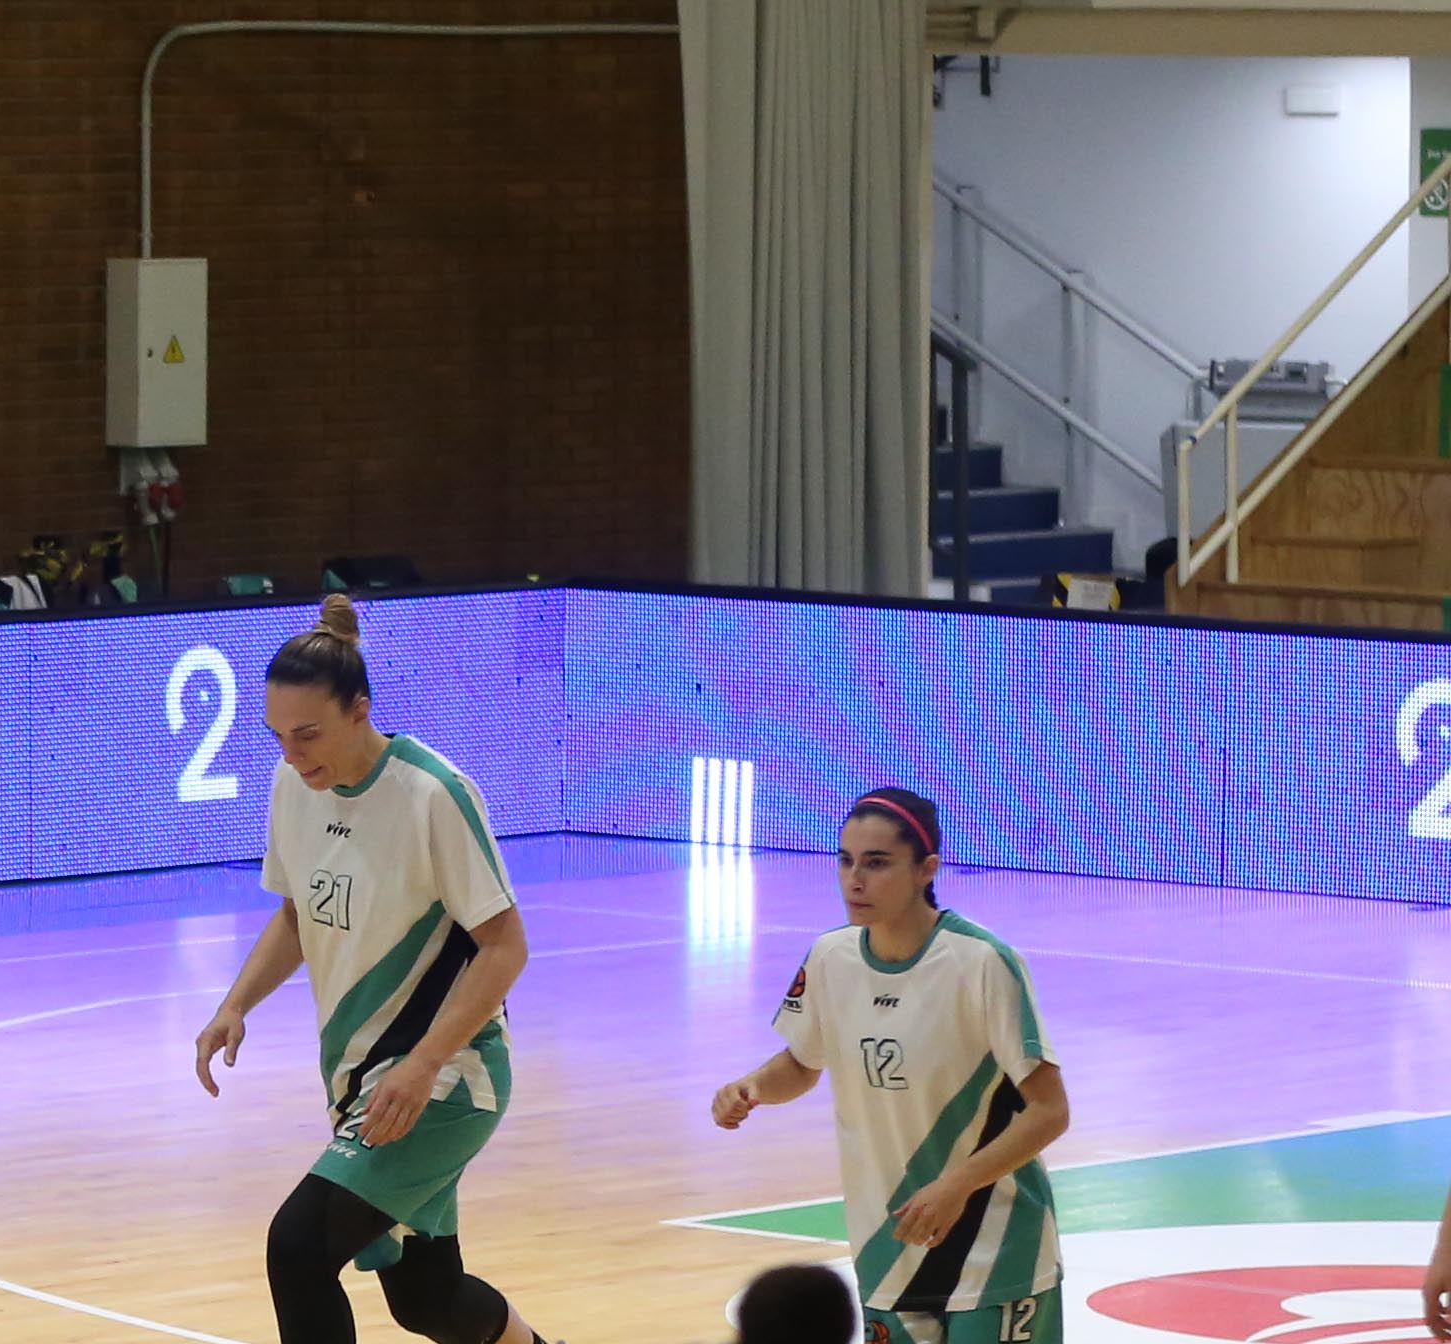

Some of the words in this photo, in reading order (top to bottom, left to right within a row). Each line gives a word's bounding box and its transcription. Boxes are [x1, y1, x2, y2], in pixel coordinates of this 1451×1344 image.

[165, 644, 238, 802] 2
[1397, 678, 1451, 839] 2
[307, 869, 353, 931] 21
[860, 1037, 909, 1091] 12
[999, 1296, 1038, 1344] 12
